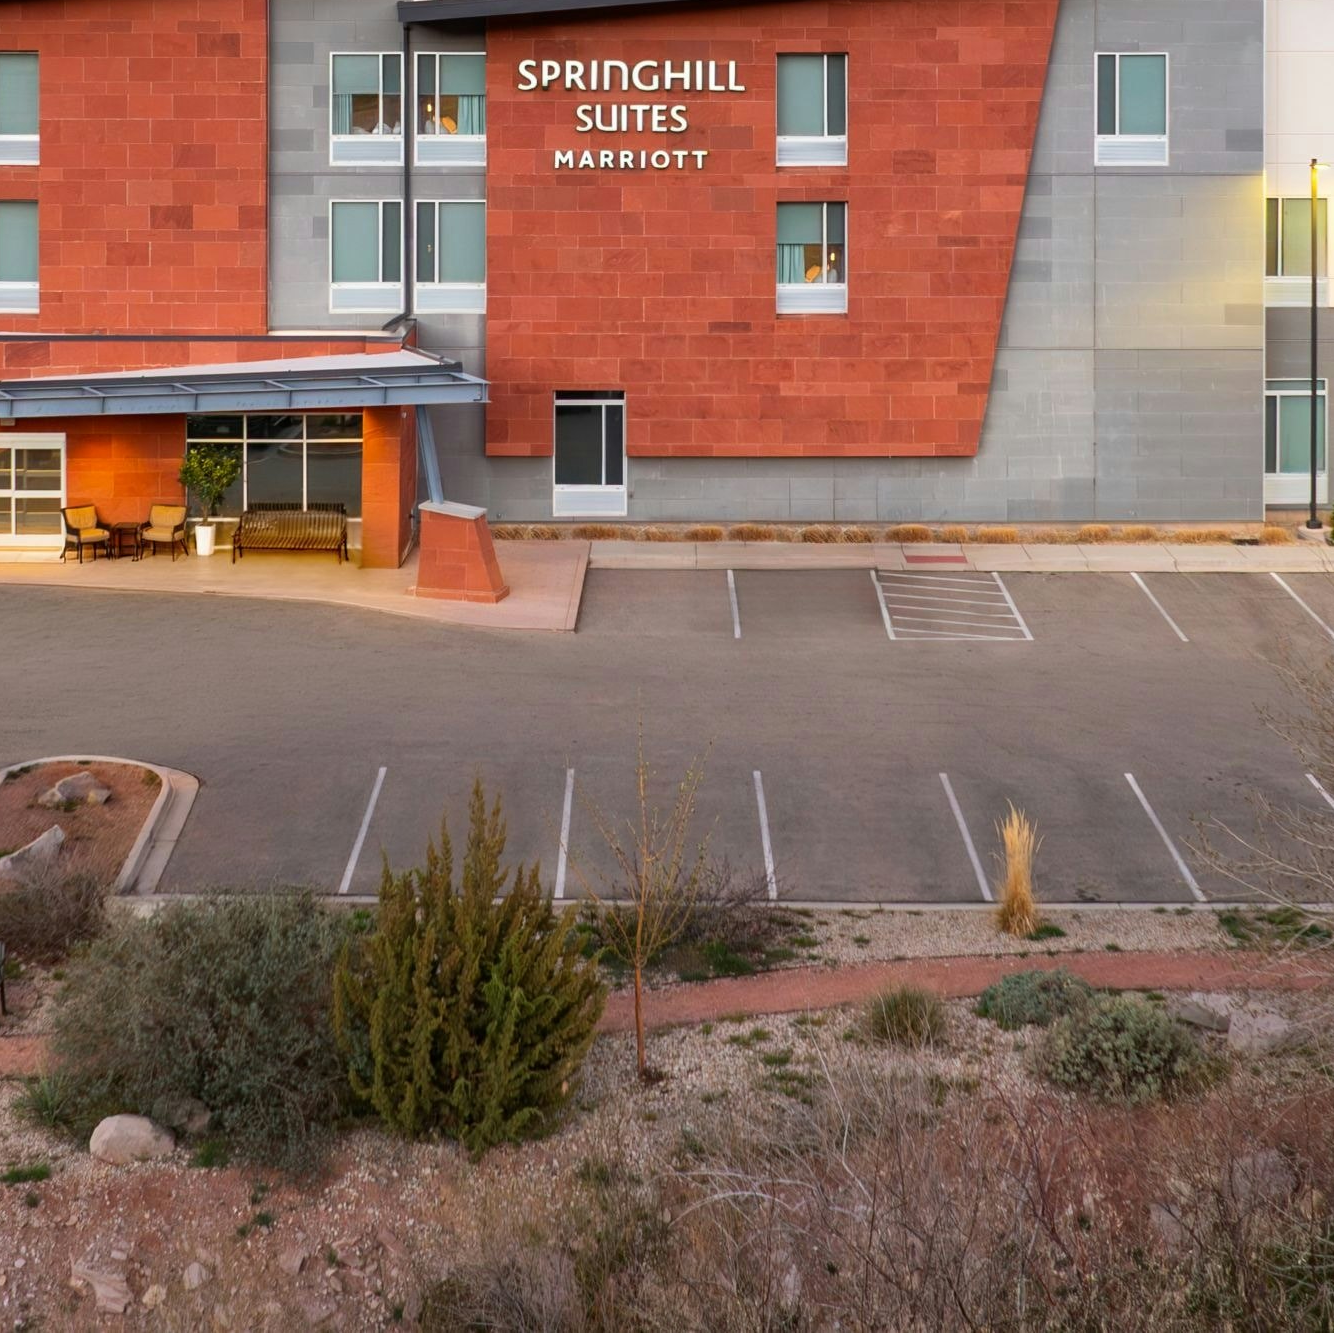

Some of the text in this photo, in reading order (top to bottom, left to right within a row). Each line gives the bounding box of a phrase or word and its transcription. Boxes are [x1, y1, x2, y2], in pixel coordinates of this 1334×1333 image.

[517, 59, 746, 92] SPRINGHILL
[575, 103, 688, 133] SUITES
[553, 149, 709, 169] MARRIOTT
